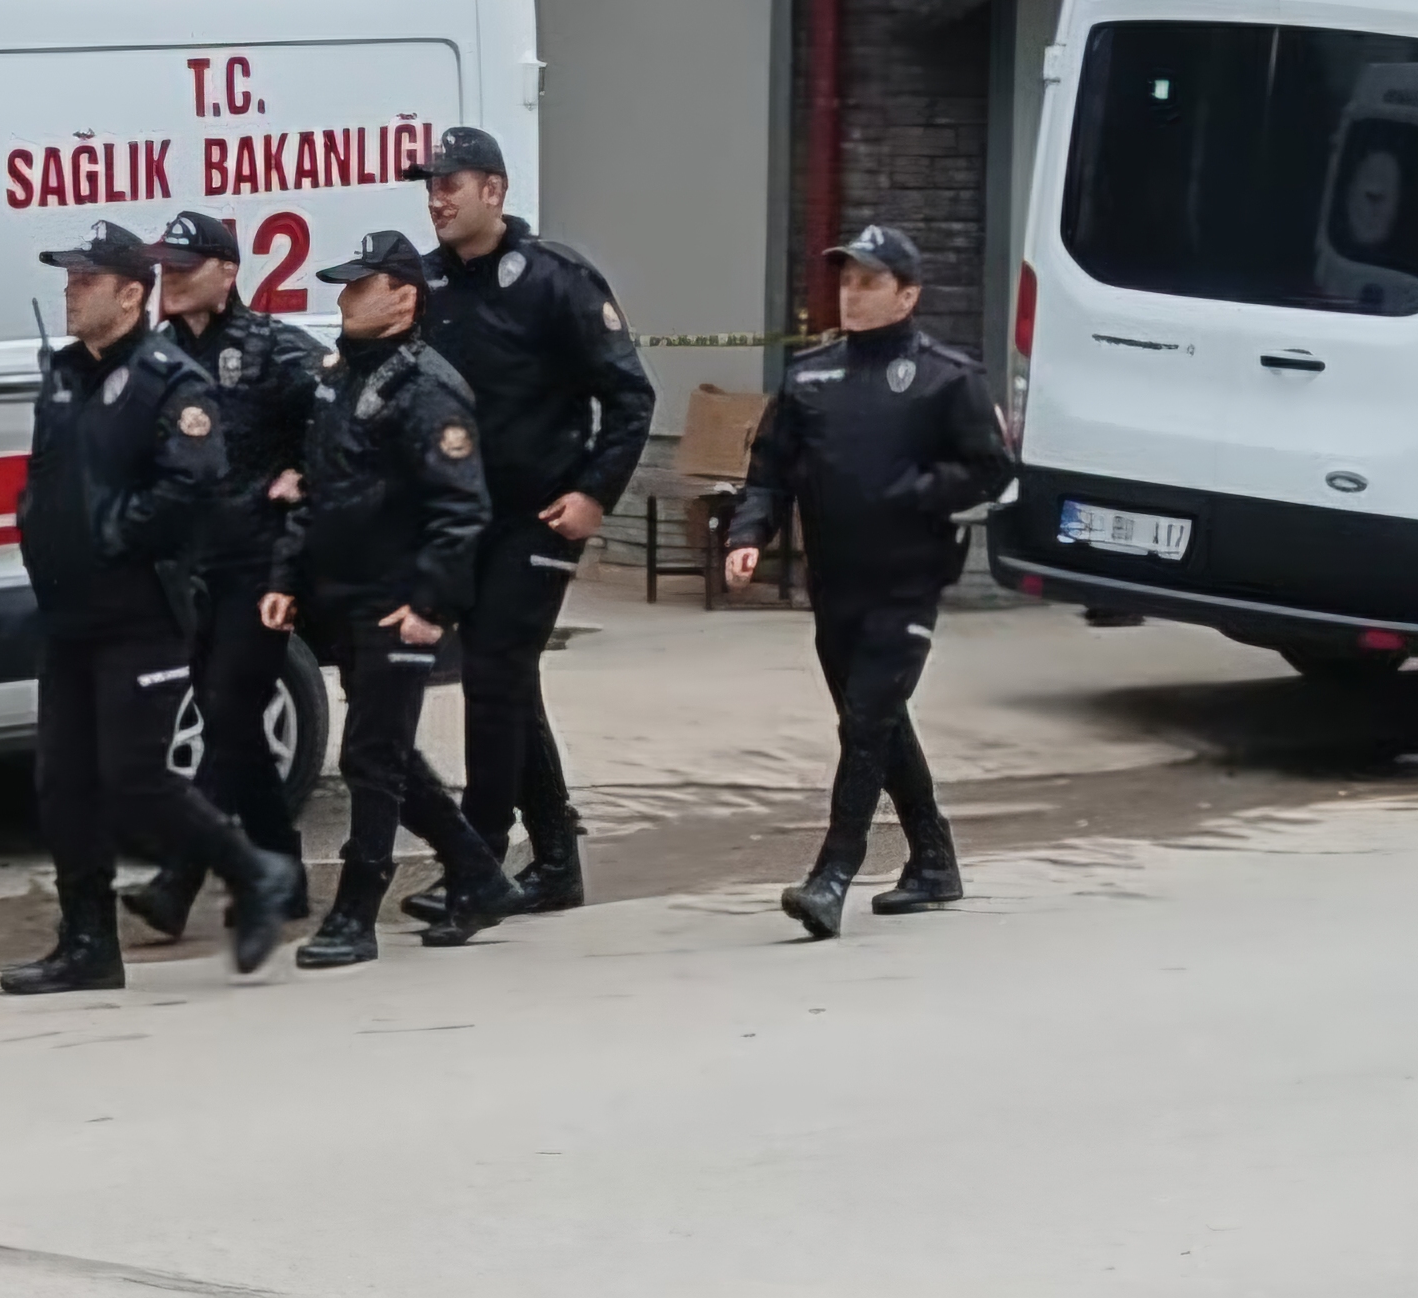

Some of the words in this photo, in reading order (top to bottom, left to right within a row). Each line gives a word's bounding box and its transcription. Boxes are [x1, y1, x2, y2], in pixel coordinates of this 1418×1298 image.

[187, 56, 266, 117] T.C.
[5, 128, 172, 210] SAĞLIK
[203, 112, 433, 197] BAKANLIĞI
